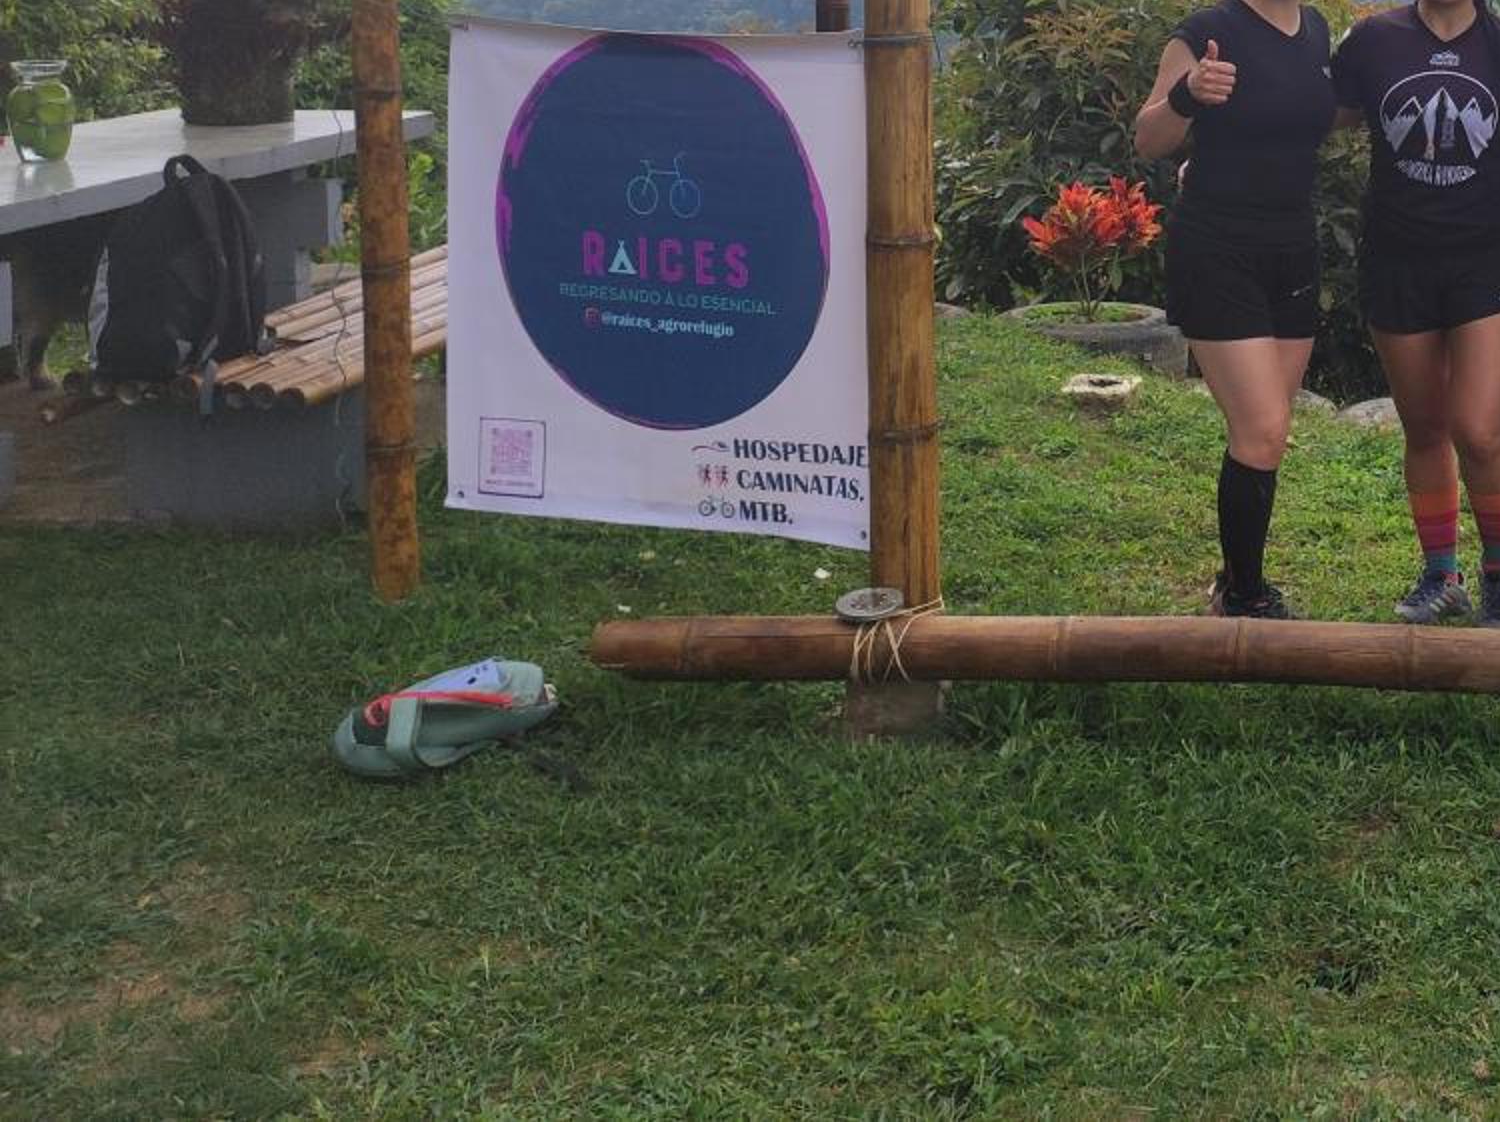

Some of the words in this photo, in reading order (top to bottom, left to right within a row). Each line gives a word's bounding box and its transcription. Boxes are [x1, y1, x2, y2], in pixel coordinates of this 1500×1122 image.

[582, 230, 749, 288] RAICES
[559, 282, 660, 304] REGRESANDO
[664, 290, 675, 307] A
[678, 294, 699, 309] LO
[701, 295, 776, 315] ESENCIAL
[736, 469, 865, 502] CAMINATAS.
[739, 499, 793, 524] MTB.
